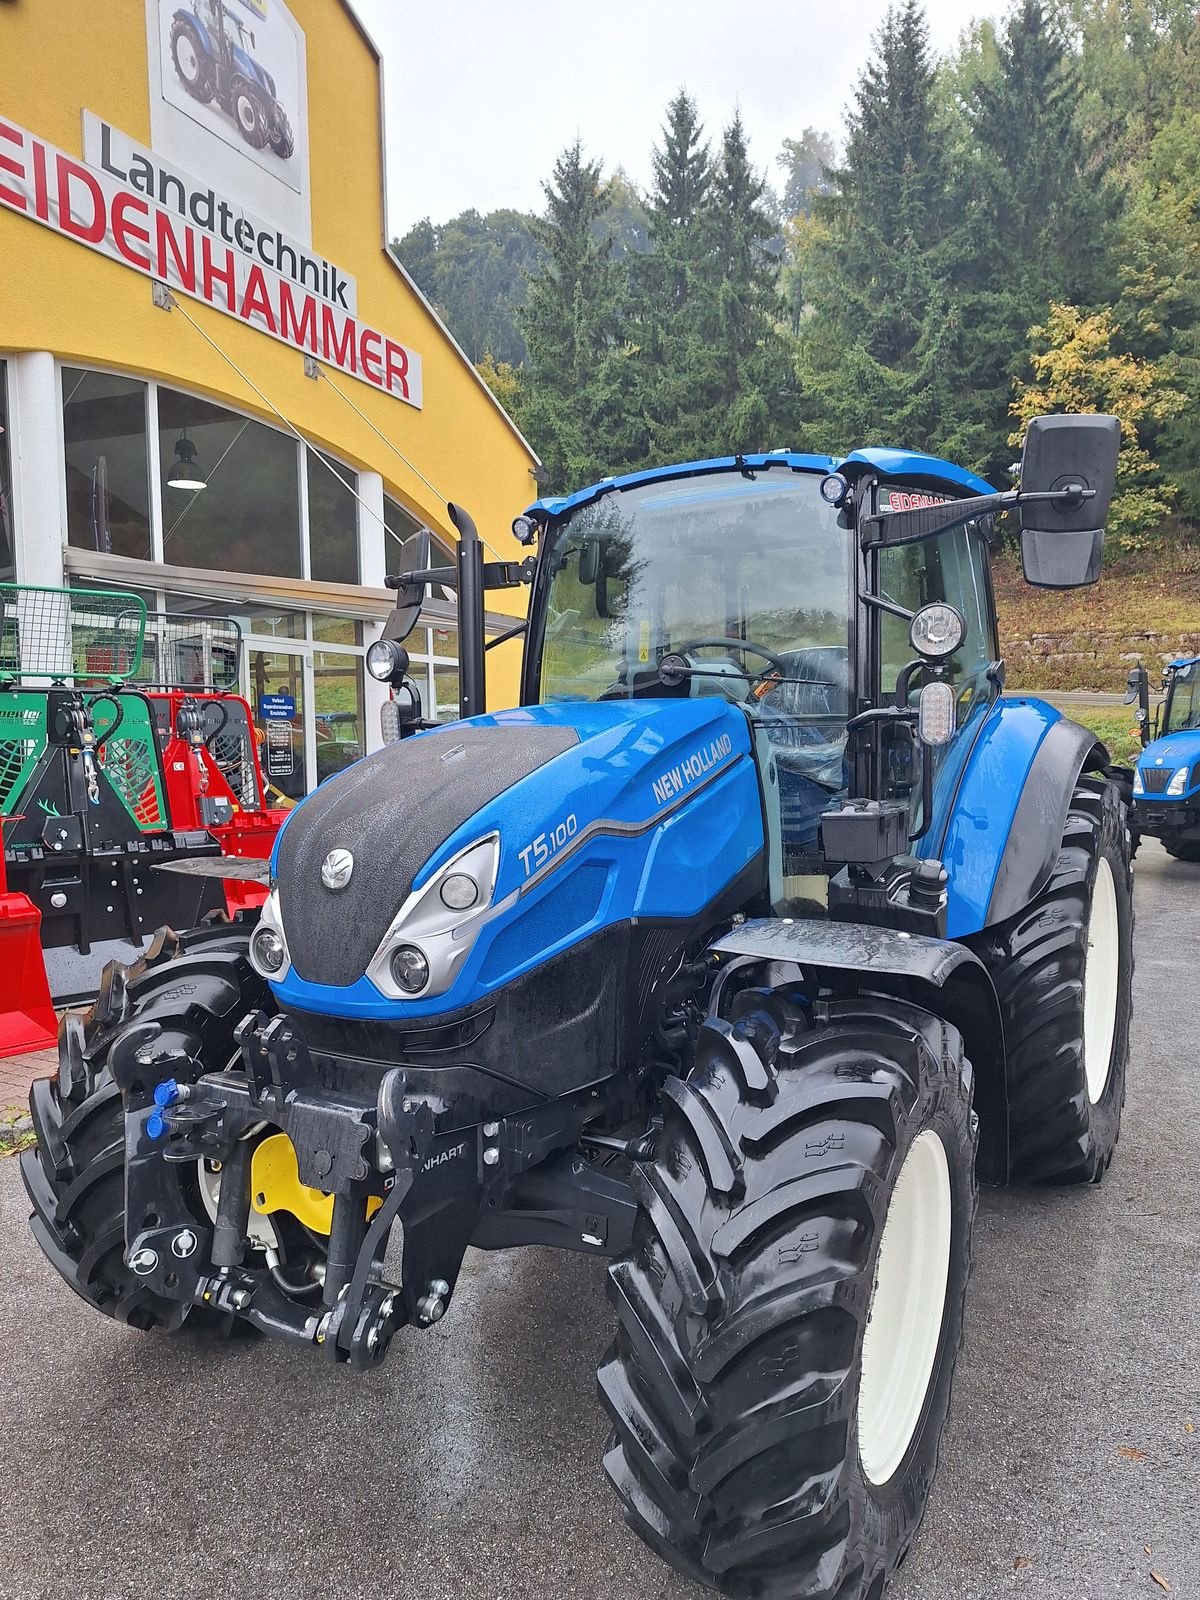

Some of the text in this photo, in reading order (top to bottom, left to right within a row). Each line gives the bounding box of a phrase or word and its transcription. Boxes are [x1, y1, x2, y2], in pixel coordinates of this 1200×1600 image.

[101, 123, 349, 310] Landtechnik
[0, 122, 410, 400] EIDENHAMMER
[652, 732, 732, 804] NEW HOLLAND
[518, 813, 577, 876] T5.100
[384, 1143, 465, 1190] DNHART
